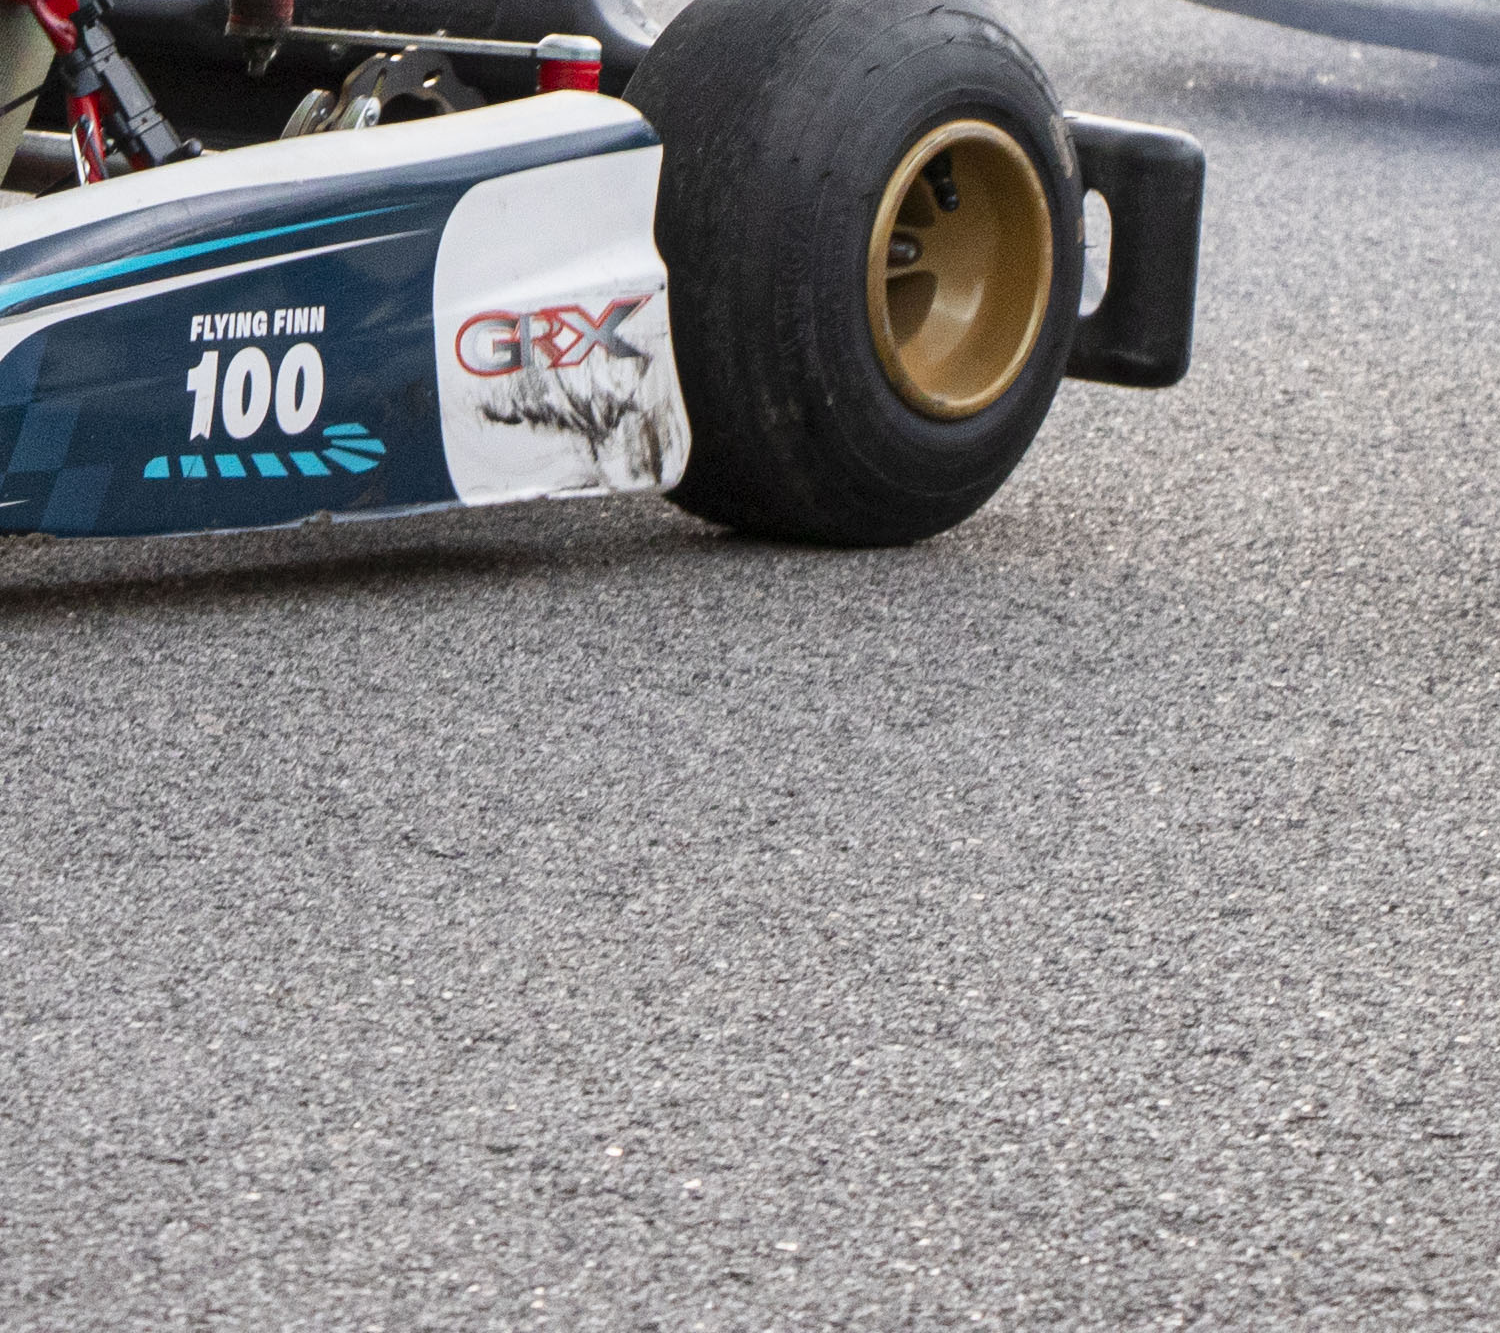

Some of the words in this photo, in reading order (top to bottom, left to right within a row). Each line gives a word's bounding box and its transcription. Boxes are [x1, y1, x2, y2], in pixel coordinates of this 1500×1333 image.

[189, 310, 269, 342] FLYING
[272, 305, 326, 336] FINN
[455, 293, 655, 377] GRX
[186, 341, 325, 442] 100
